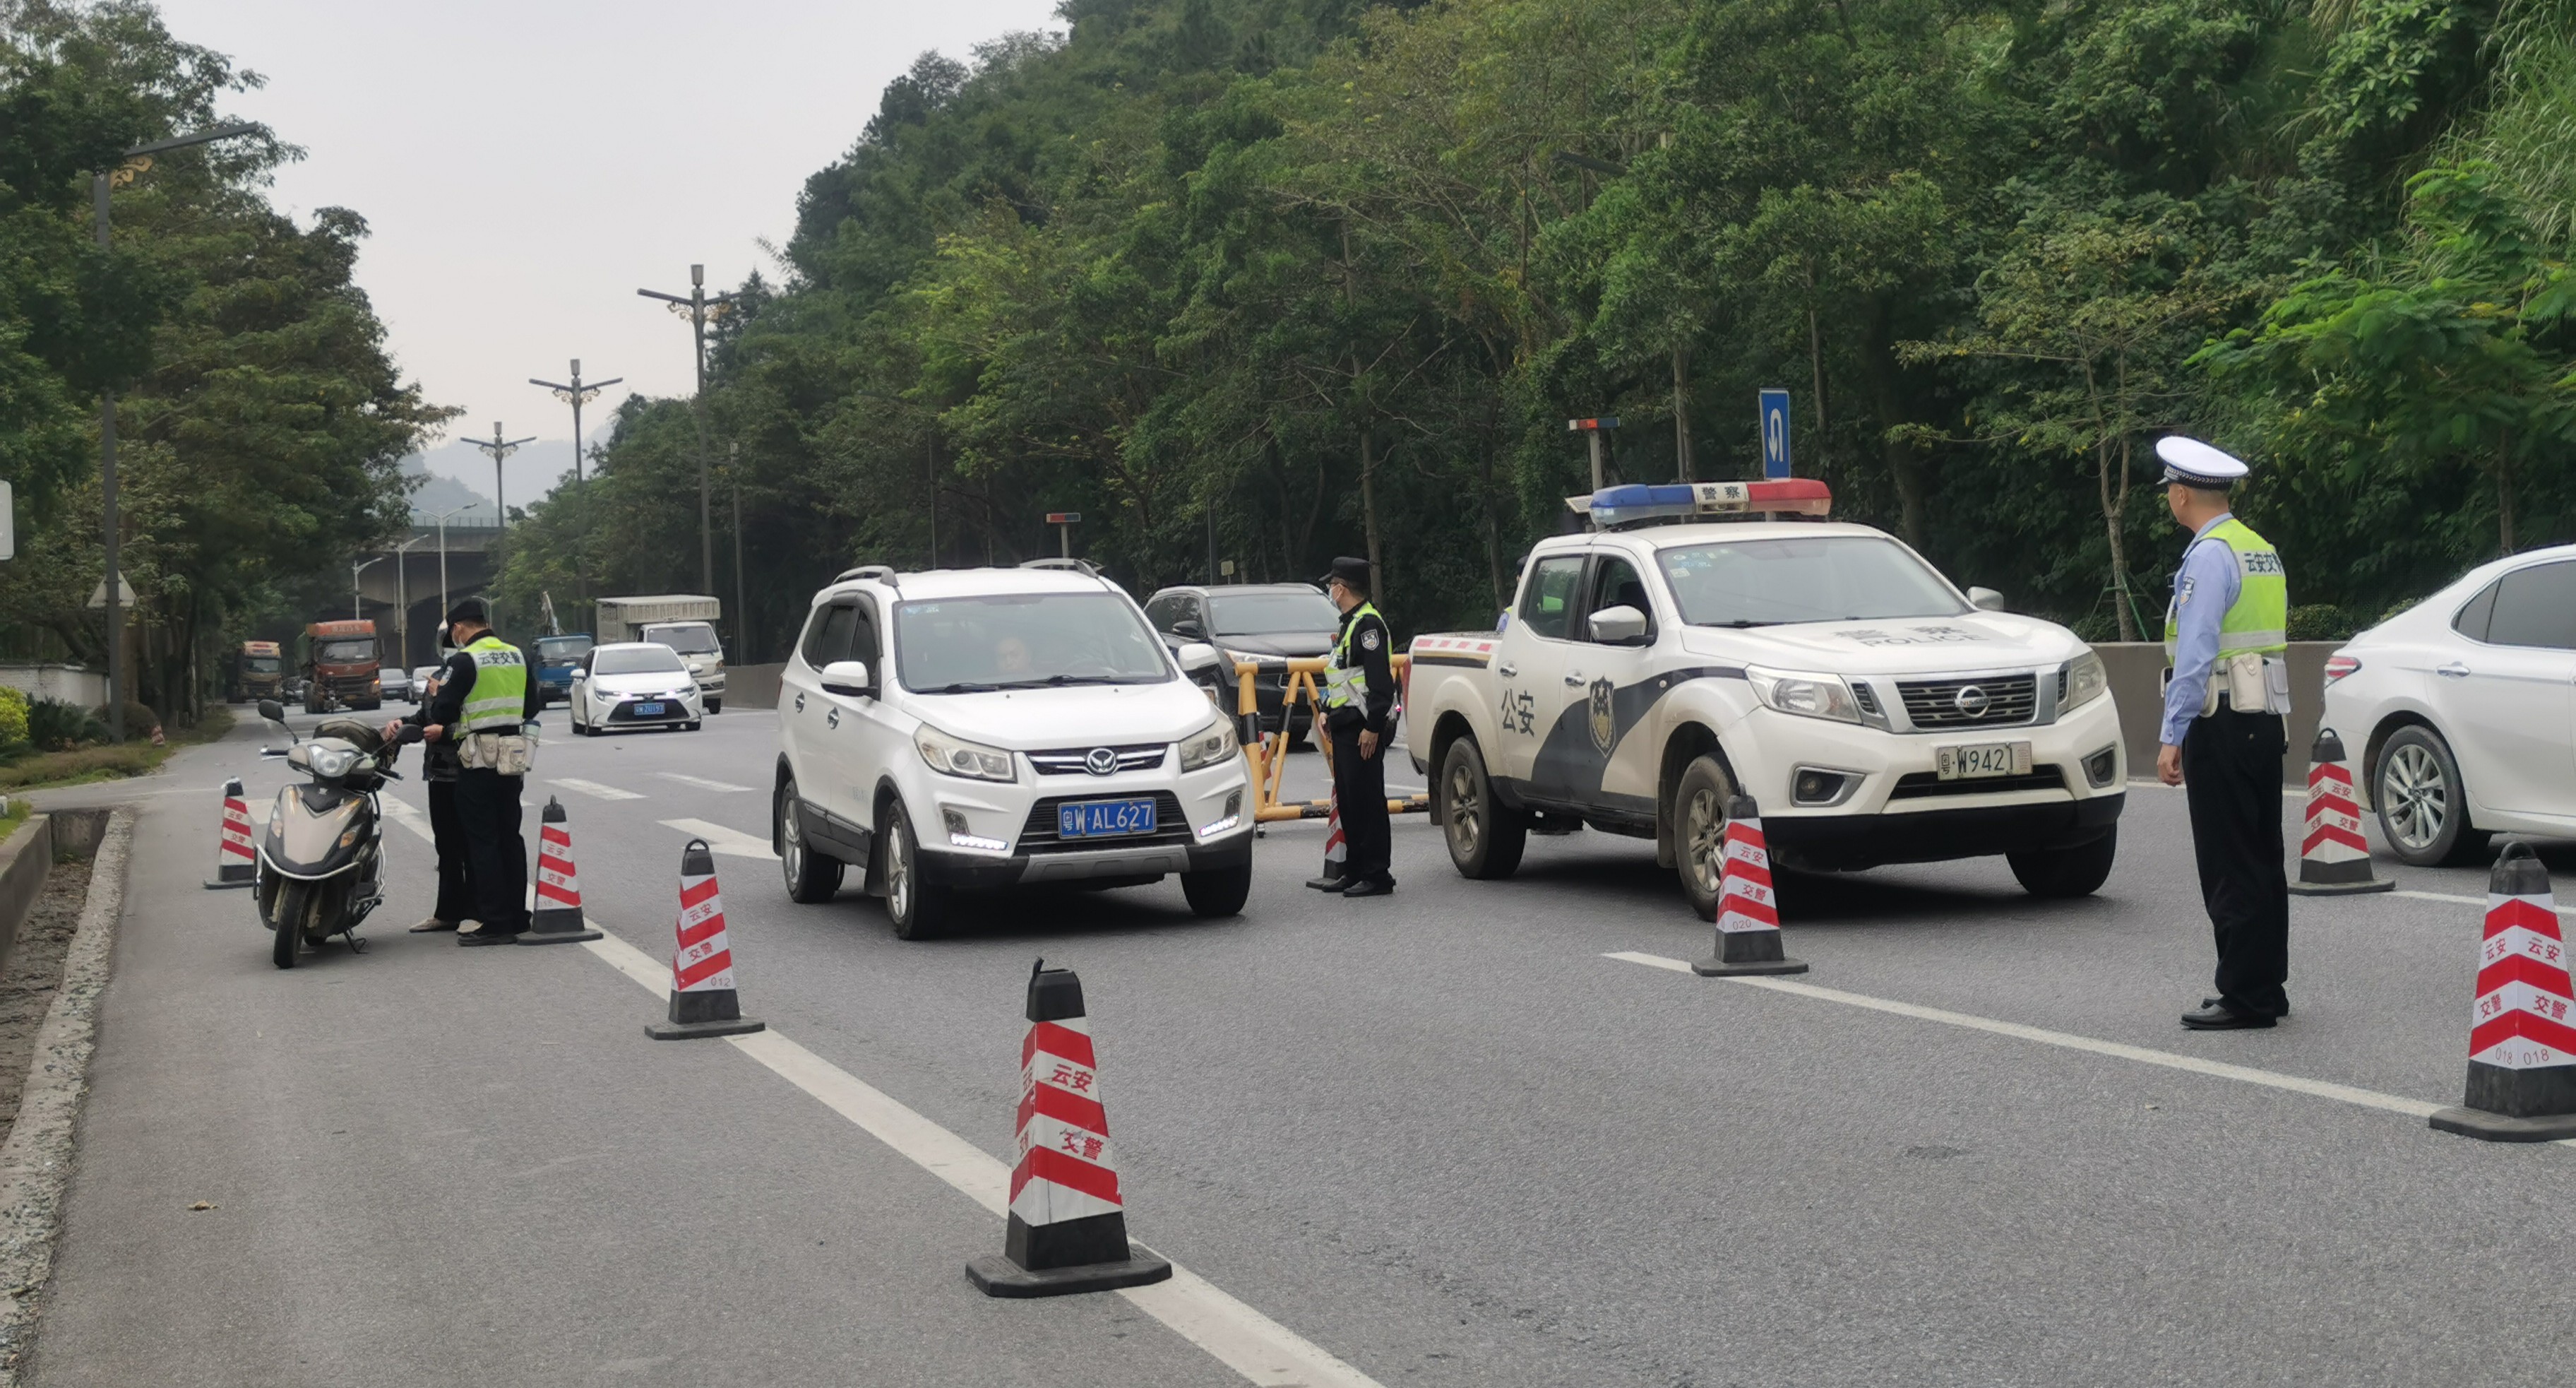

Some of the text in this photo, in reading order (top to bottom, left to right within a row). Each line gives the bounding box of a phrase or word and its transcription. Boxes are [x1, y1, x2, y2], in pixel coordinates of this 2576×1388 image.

[1701, 486, 1740, 499] 警察
[1861, 635, 1990, 646] POLICE
[1501, 689, 1534, 737] 公安
[2332, 783, 2351, 797] 云安
[2339, 817, 2358, 831] 交警
[1741, 846, 1764, 864] 云安
[547, 872, 566, 886] 交警
[1742, 884, 1767, 901] 交警
[688, 903, 713, 922] 云安
[1732, 919, 1752, 930] 020
[688, 942, 713, 961] 交警
[2486, 937, 2506, 961] 云安
[2528, 937, 2560, 963] 云安
[710, 977, 731, 987] 012
[2480, 993, 2501, 1019] 交警
[2534, 995, 2568, 1021] 交警
[2495, 1047, 2512, 1065] 018
[2523, 1048, 2549, 1065] 018
[1052, 1063, 1094, 1093] 云安
[1059, 1128, 1104, 1161] 交警
